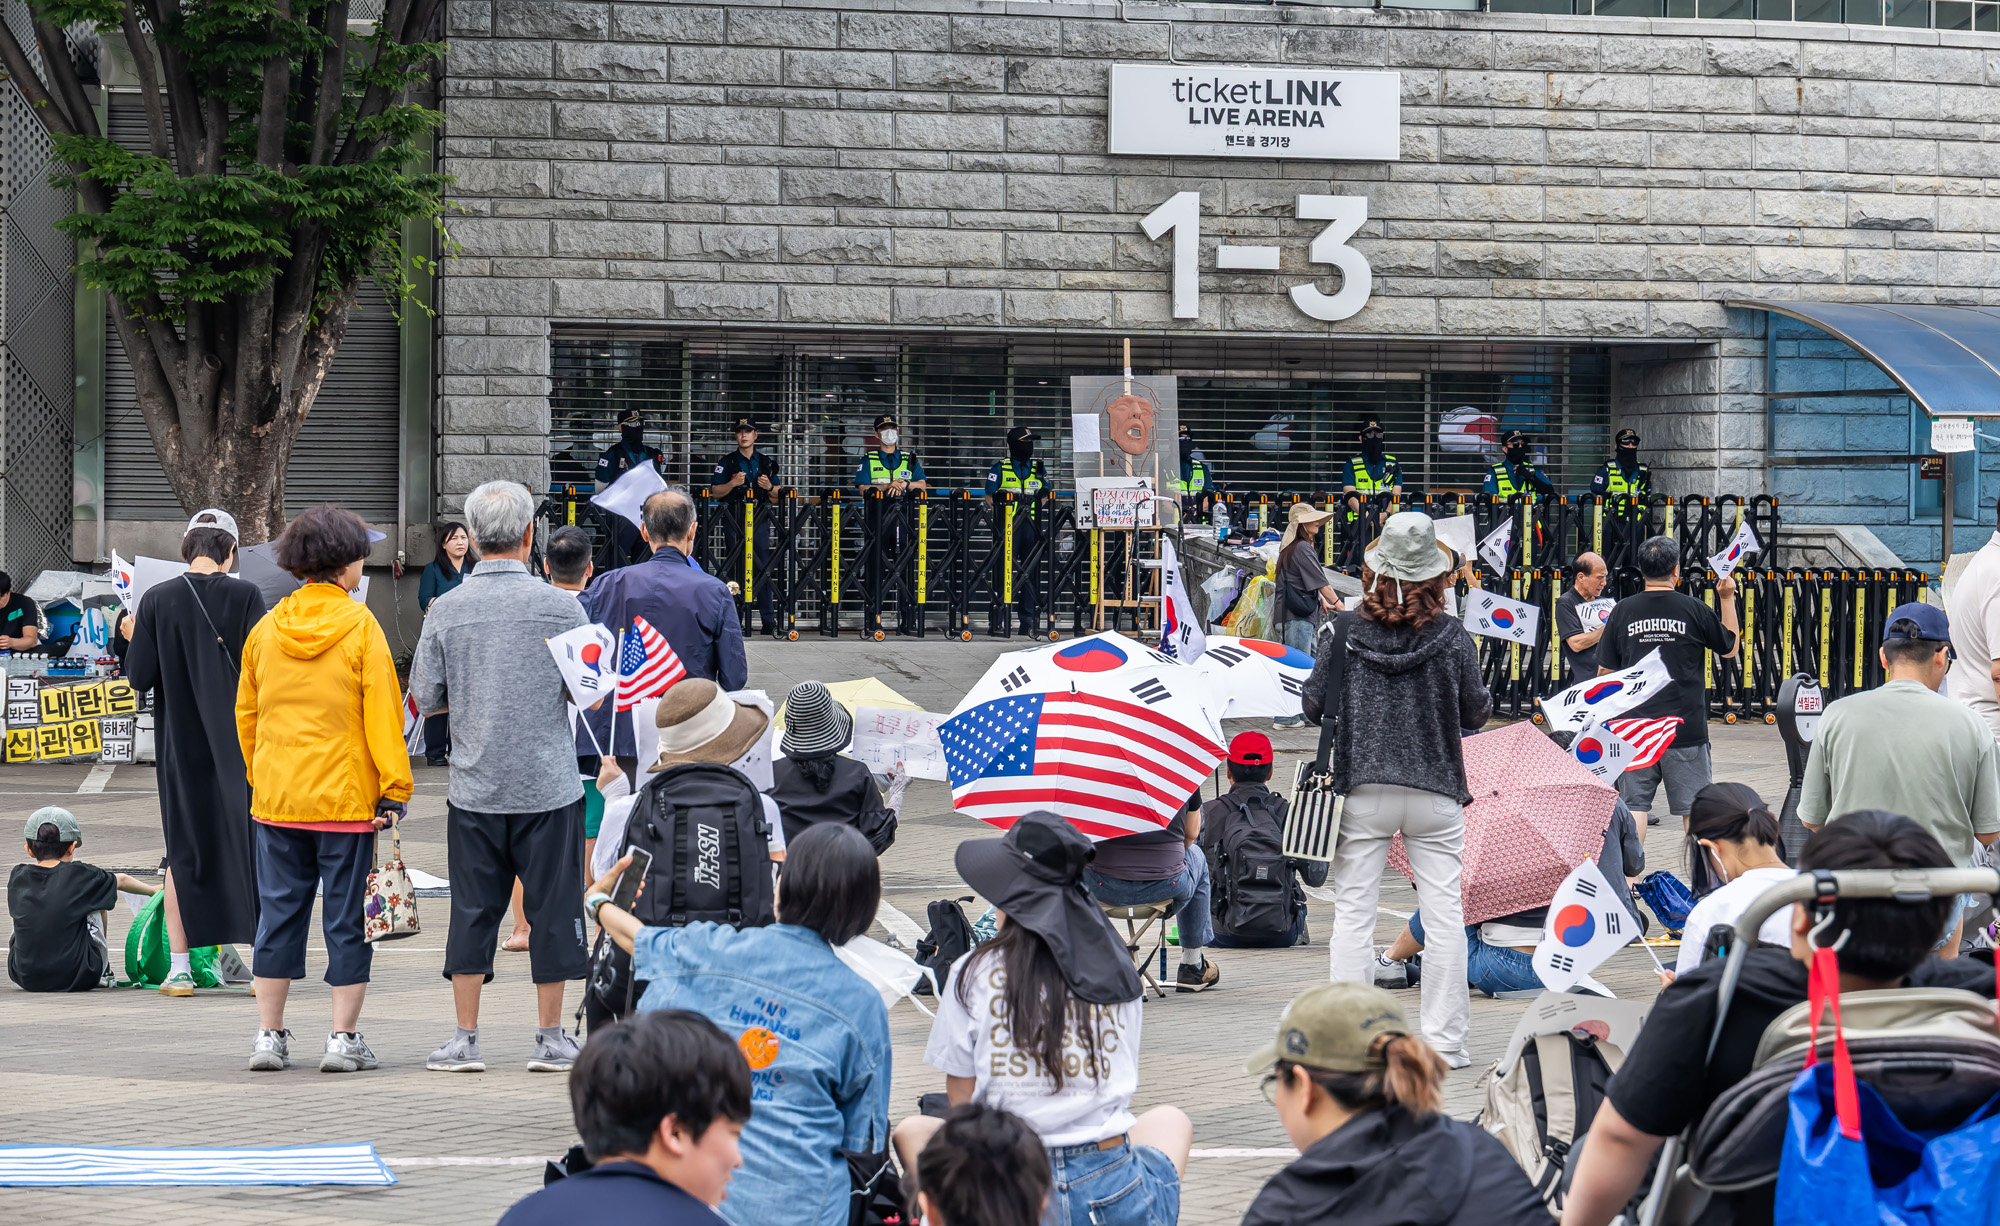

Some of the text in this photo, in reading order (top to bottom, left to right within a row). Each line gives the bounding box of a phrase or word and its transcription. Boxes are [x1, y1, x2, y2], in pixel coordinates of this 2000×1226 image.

[1172, 77, 1342, 106] ticketLINK
[1189, 107, 1325, 127] LIVE ARENA
[1225, 134, 1291, 148] 핸드볼 경기장
[1138, 191, 1372, 321] 1-3
[1628, 618, 1686, 636] SHOHOKU
[9, 682, 38, 697] 누가
[44, 685, 135, 718] 내란은
[9, 706, 37, 721] 봐도
[8, 721, 98, 758] 선관위
[103, 744, 131, 758] 하라
[1064, 1053, 1110, 1080] 969
